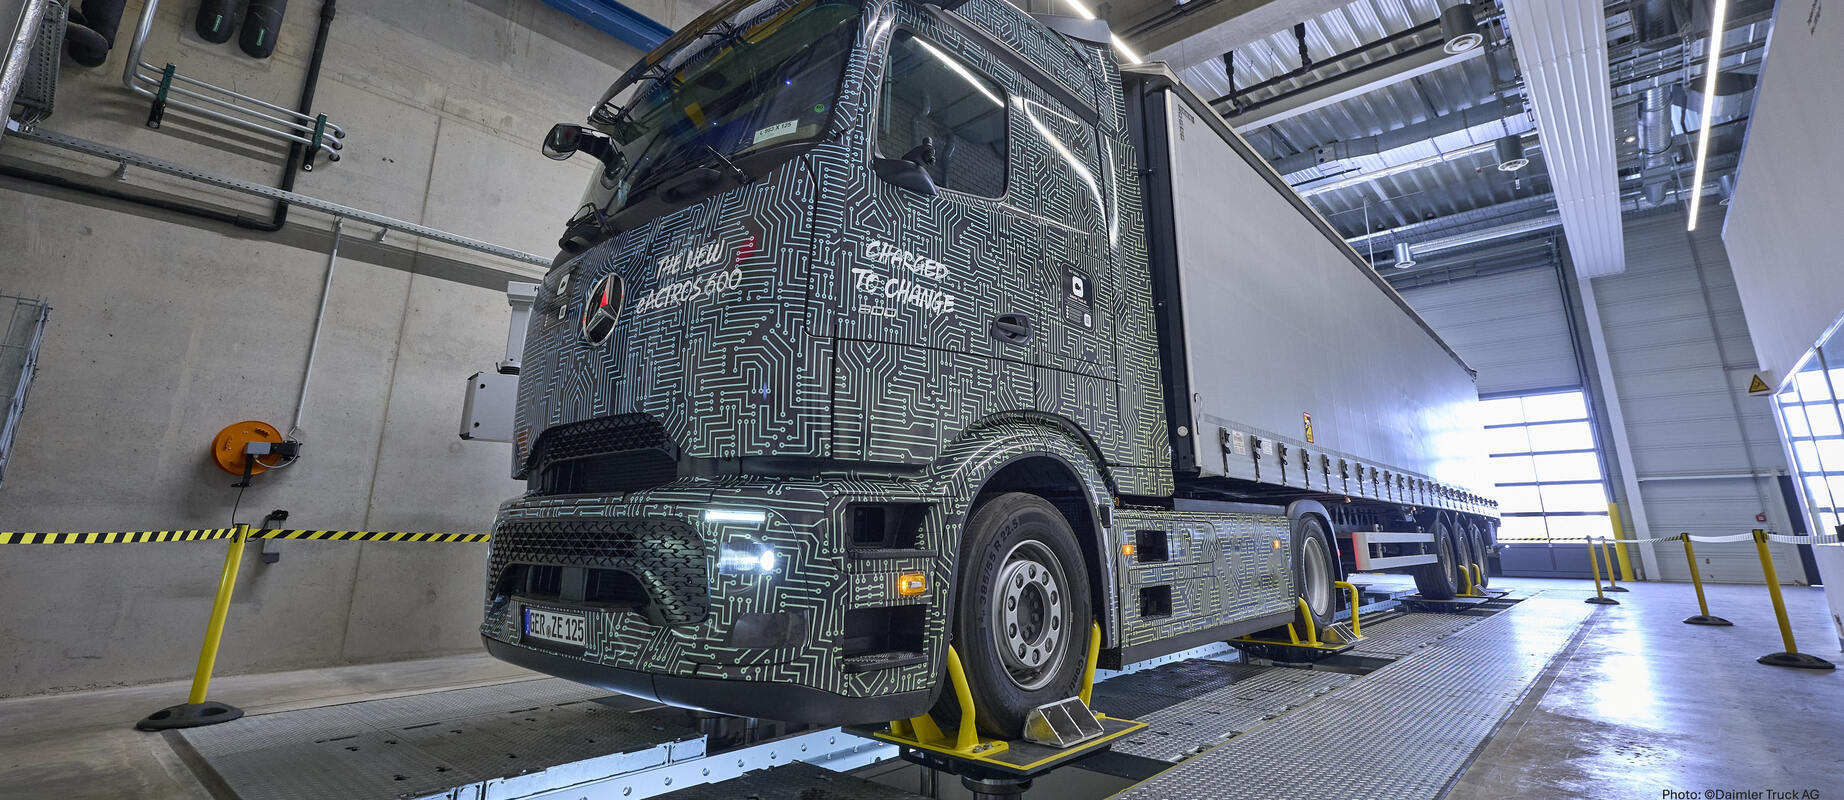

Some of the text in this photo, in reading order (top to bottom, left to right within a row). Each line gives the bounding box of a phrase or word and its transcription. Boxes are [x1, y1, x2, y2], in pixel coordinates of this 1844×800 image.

[657, 240, 724, 280] THE NEW
[865, 240, 950, 280] CHARGED
[637, 268, 742, 314] eACTROS 600
[851, 267, 955, 316] TO CHANGE
[993, 542, 1002, 552] R
[1000, 519, 1019, 541] 22.5
[530, 612, 584, 642] GER ZE 125
